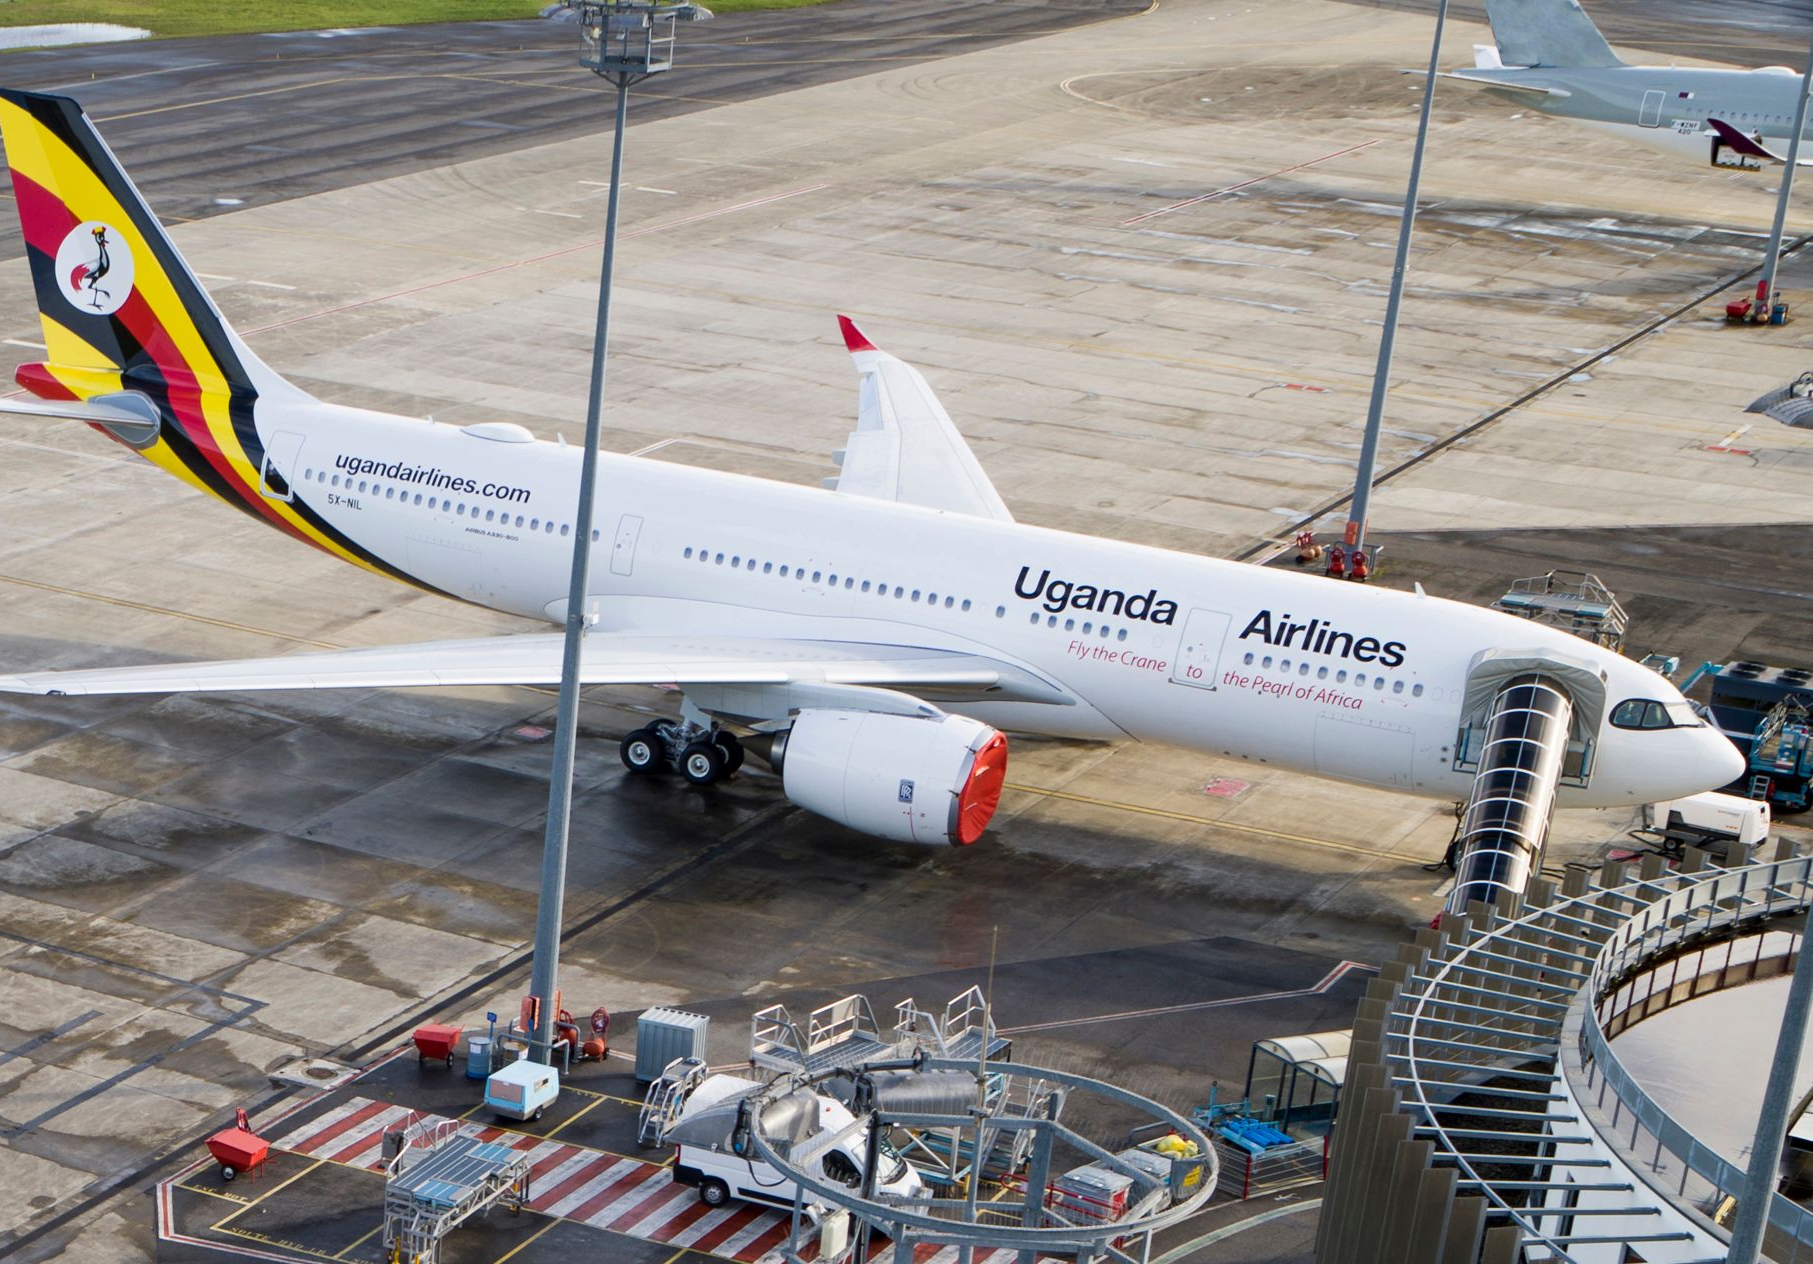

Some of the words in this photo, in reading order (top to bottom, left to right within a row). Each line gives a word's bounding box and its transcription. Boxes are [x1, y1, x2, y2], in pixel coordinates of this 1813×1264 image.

[328, 493, 362, 511] 5X-NIL
[336, 454, 531, 504] ugandairlines.com
[1014, 566, 1178, 626] Uganda
[1239, 610, 1406, 668] Airlines
[1067, 640, 1091, 661] Fly
[1092, 643, 1119, 665] the
[1120, 650, 1168, 674] Crane
[1187, 664, 1204, 681] to
[1223, 670, 1249, 688] the
[1251, 676, 1293, 698] Pearl
[1295, 683, 1316, 701] of
[1313, 689, 1363, 711] Africa
